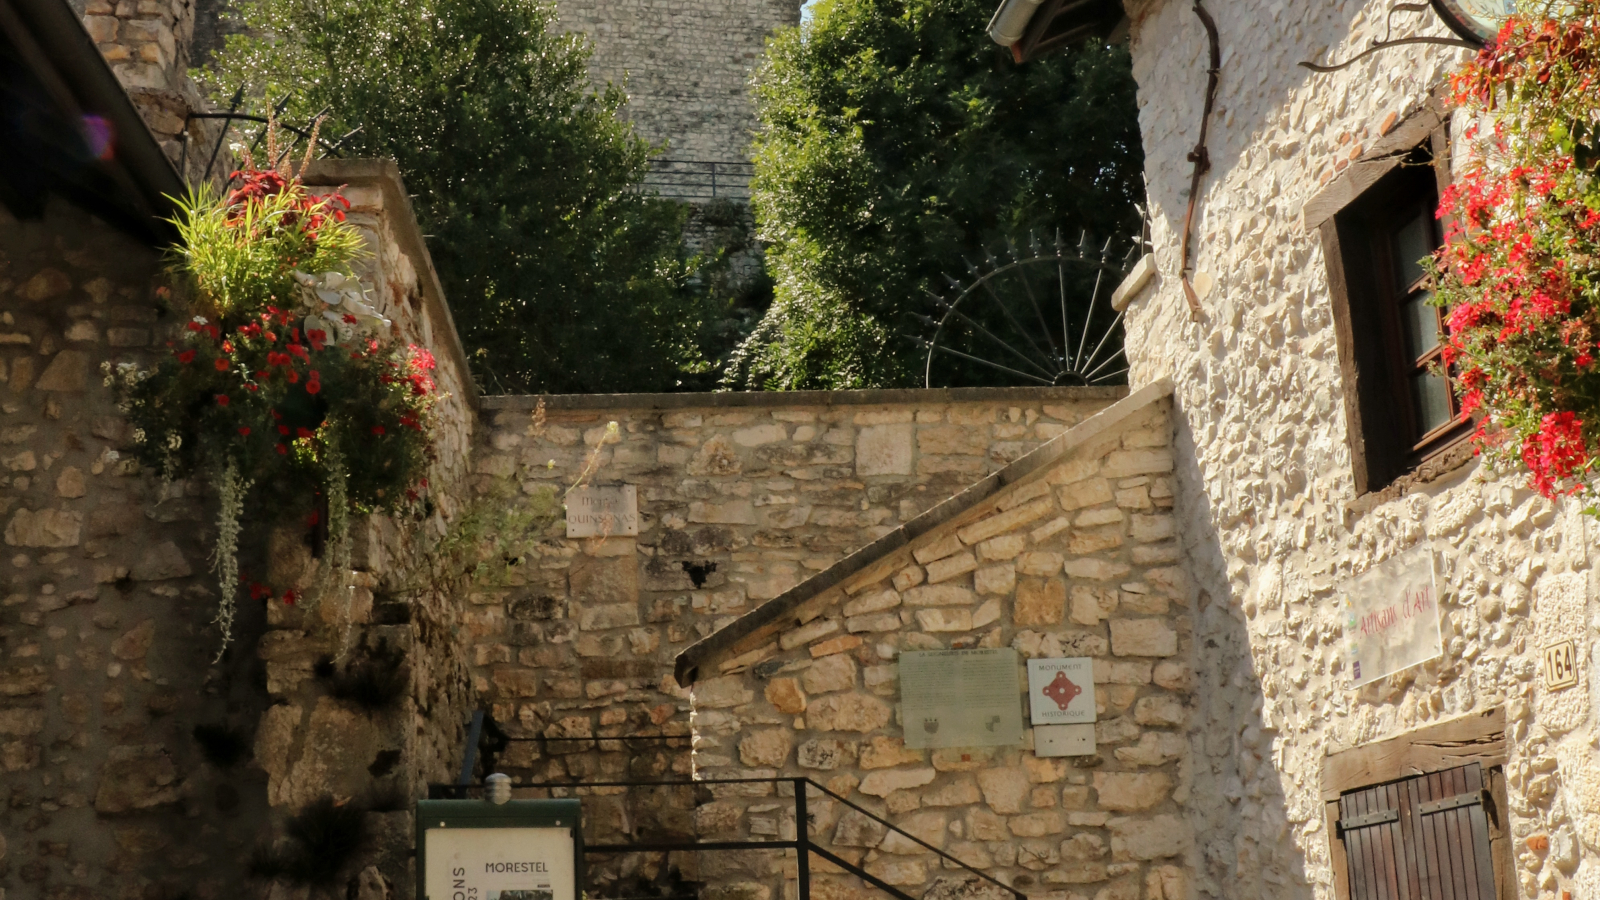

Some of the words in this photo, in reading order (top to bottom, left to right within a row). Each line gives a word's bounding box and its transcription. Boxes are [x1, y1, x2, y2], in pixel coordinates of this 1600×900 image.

[568, 513, 636, 524] QUINSONAS
[1402, 585, 1431, 619] d'Art
[1038, 663, 1082, 671] MONUMENT
[1547, 645, 1573, 681] 164
[1041, 710, 1086, 718] HISTORIQUE
[485, 862, 549, 873] MORESTEL
